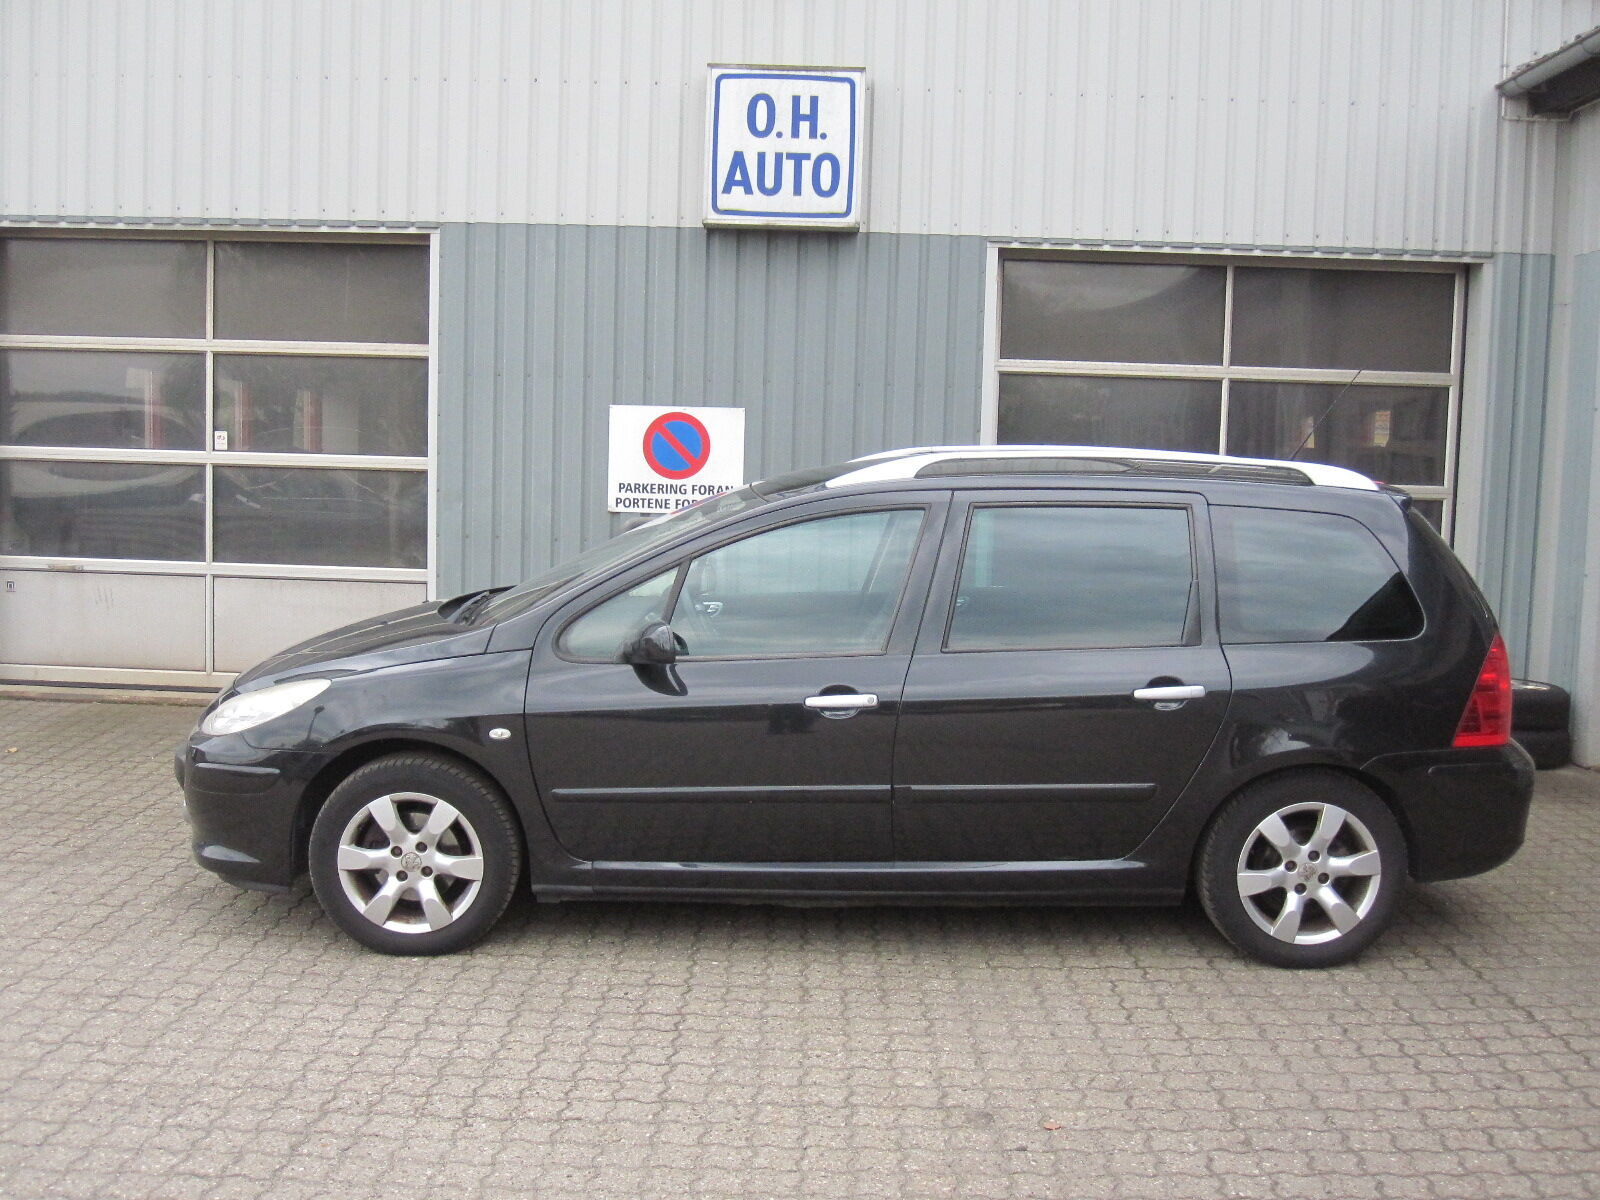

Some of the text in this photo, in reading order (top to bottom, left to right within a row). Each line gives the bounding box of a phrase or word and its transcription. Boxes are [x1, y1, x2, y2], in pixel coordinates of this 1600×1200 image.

[746, 92, 828, 140] O.H.
[721, 150, 841, 198] AUTO
[615, 497, 671, 509] PORTENE
[618, 482, 687, 495] PARKERING
